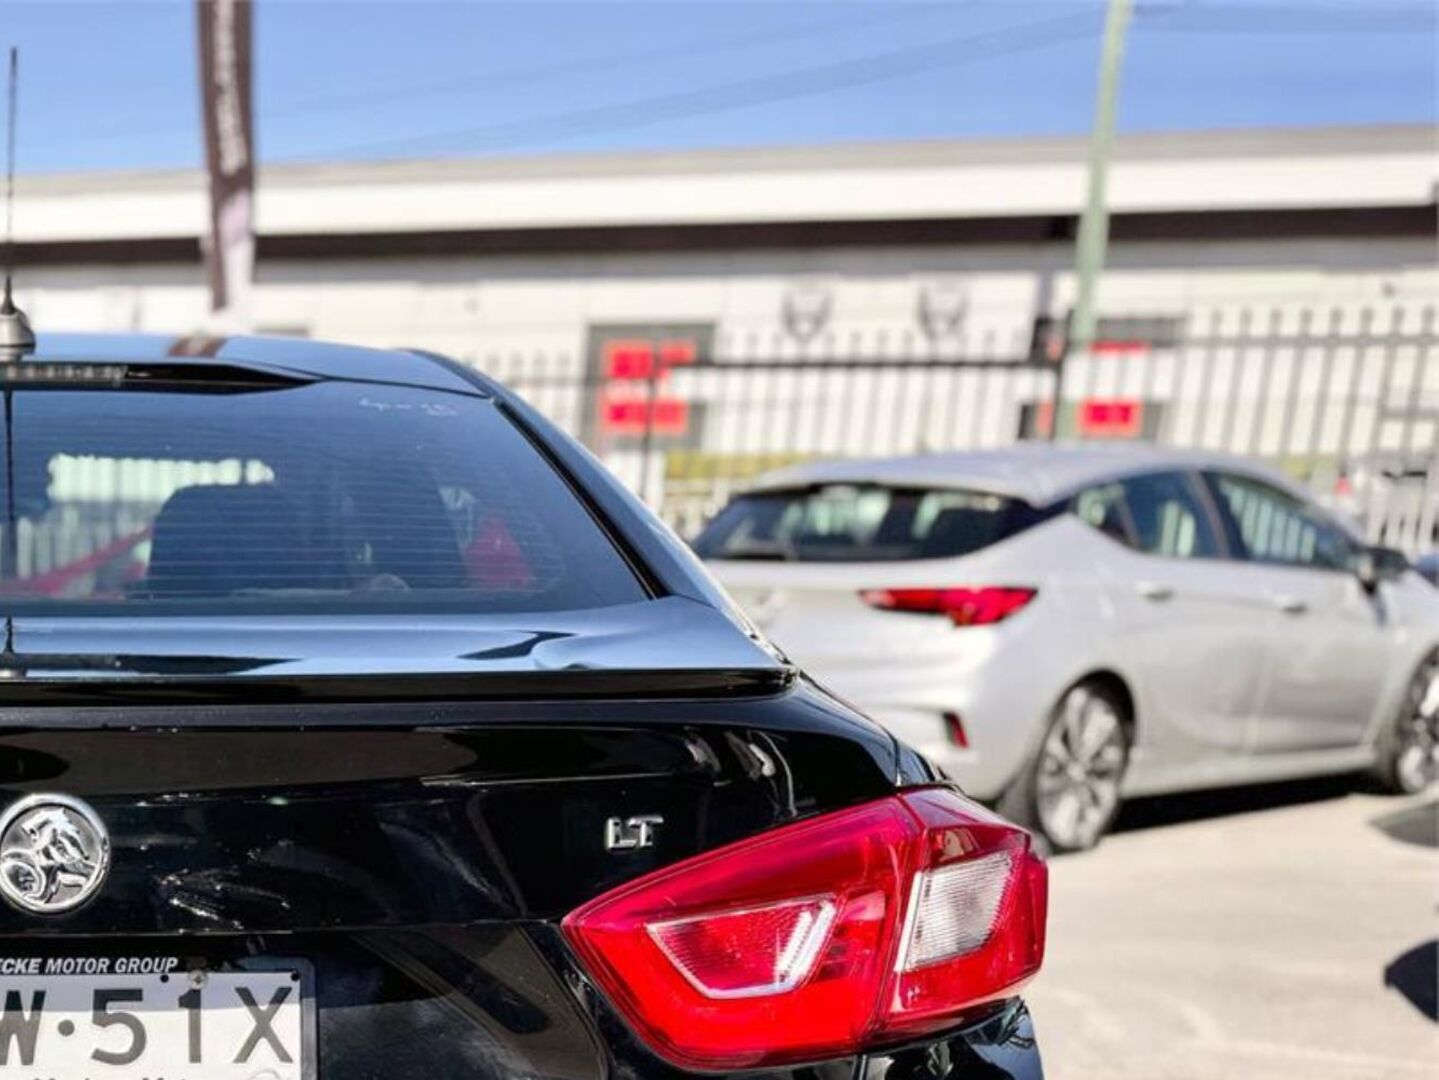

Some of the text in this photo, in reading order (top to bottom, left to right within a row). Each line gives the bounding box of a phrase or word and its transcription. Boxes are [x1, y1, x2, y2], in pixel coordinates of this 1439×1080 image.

[606, 814, 664, 849] LT
[45, 957, 114, 975] MOTOR
[115, 956, 179, 974] GROUP
